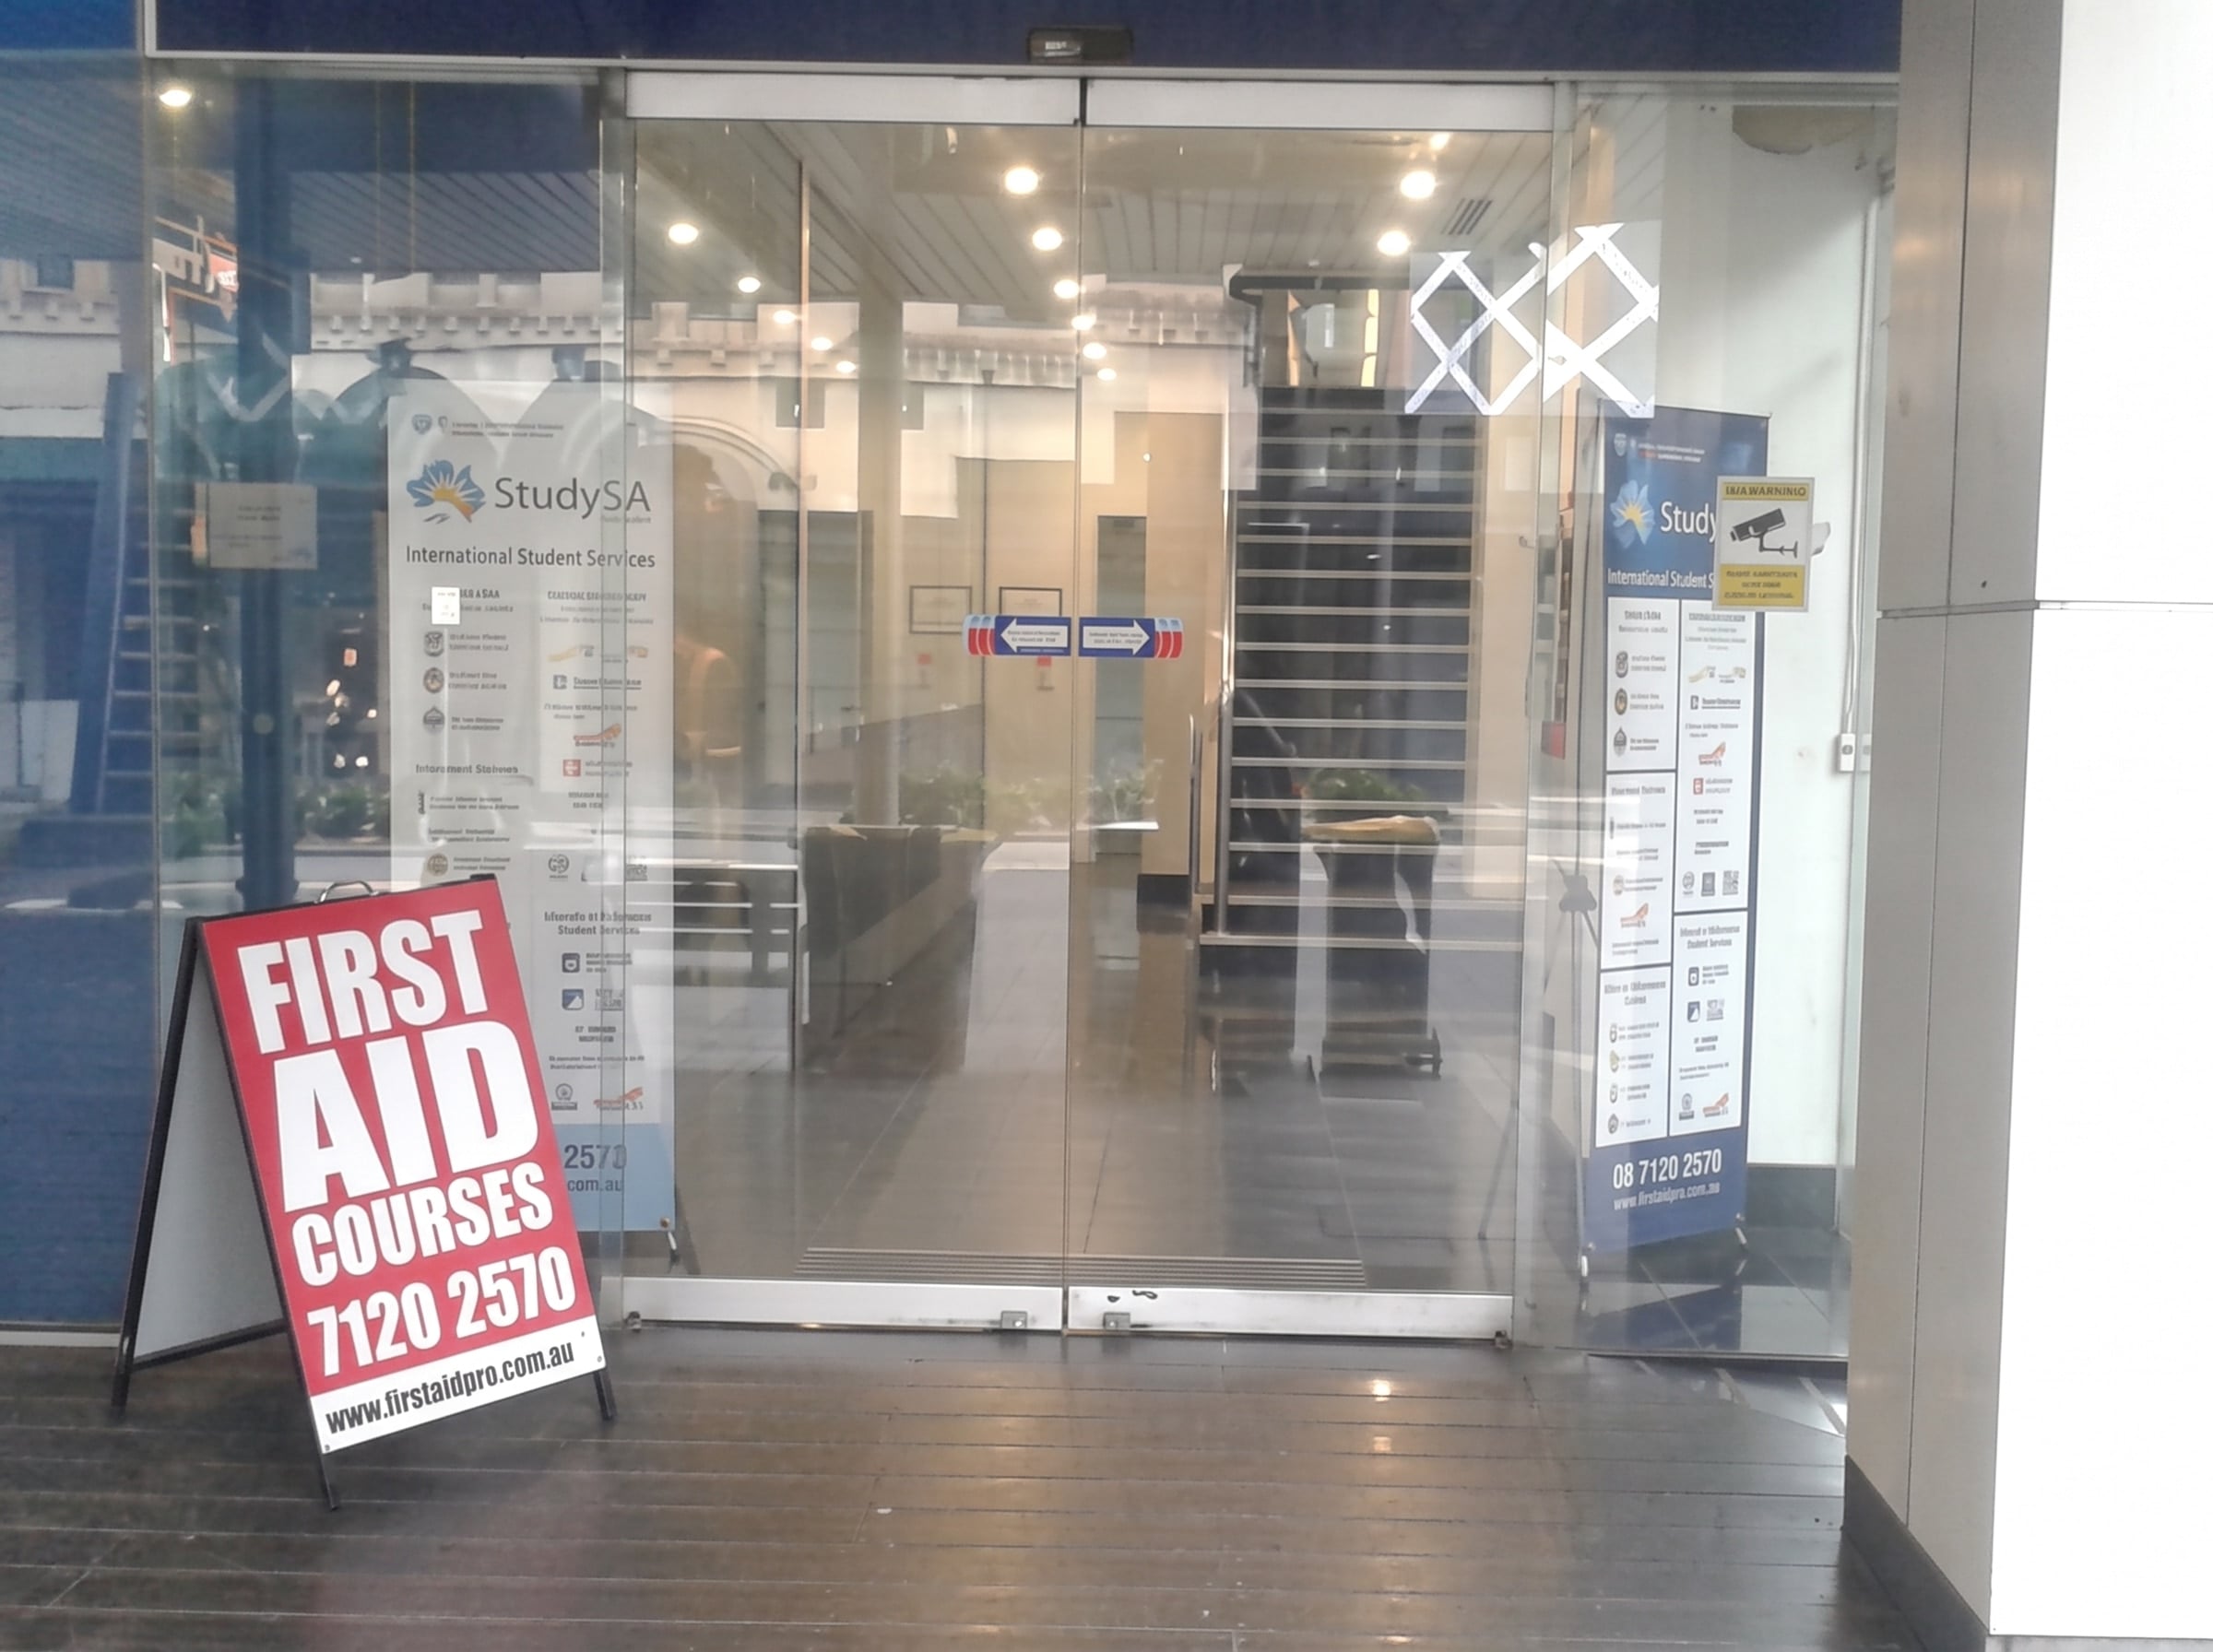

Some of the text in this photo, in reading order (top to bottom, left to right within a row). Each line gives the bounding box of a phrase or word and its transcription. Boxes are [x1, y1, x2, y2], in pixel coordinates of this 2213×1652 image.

[494, 477, 651, 520] StudySA
[1661, 501, 1716, 543] Study
[406, 546, 657, 568] International Student Services
[1607, 568, 1669, 586] International
[1670, 571, 1707, 588] Student
[237, 909, 488, 1055] FIRST
[274, 1021, 539, 1213] AID
[567, 1179, 623, 1192] com.au
[1613, 1148, 1722, 1189] 08 7120 2570
[291, 1162, 553, 1287] COURSES
[307, 1245, 576, 1377] 7120 2570
[325, 1341, 574, 1434] www.firstaidpro.com.au
